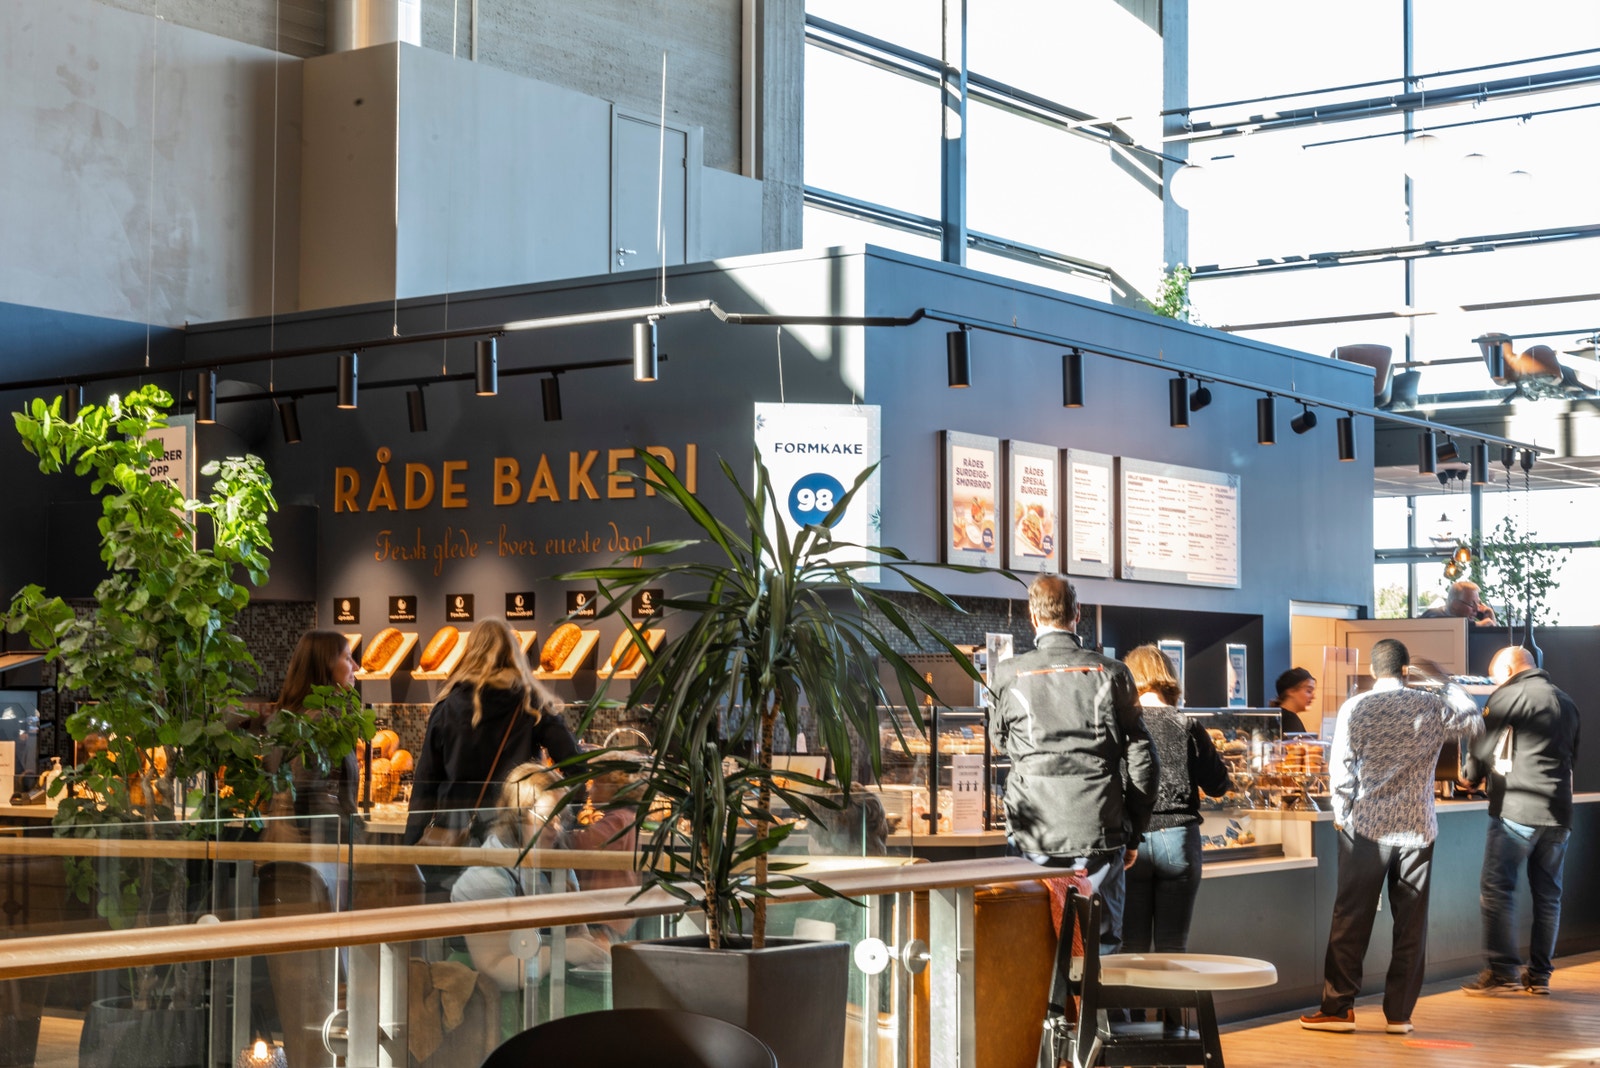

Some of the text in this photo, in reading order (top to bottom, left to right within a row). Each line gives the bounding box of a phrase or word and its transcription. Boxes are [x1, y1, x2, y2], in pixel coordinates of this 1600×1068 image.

[774, 442, 863, 455] FORMKAKE
[963, 457, 984, 469] RÅDES
[149, 465, 169, 477] OPP
[956, 467, 989, 479] SURDEIGS-
[1024, 465, 1044, 477] RÅDES
[334, 443, 697, 513] RÅDE BAKERI
[956, 477, 992, 489] SMØRBRØD
[1022, 476, 1046, 487] SPESIAL
[1020, 485, 1048, 497] BURGERE
[797, 488, 834, 512] 98
[374, 530, 427, 562] Fersk
[433, 526, 478, 577] glede
[498, 523, 538, 557] hver
[545, 530, 601, 555] eneste
[607, 520, 650, 569] dag!
